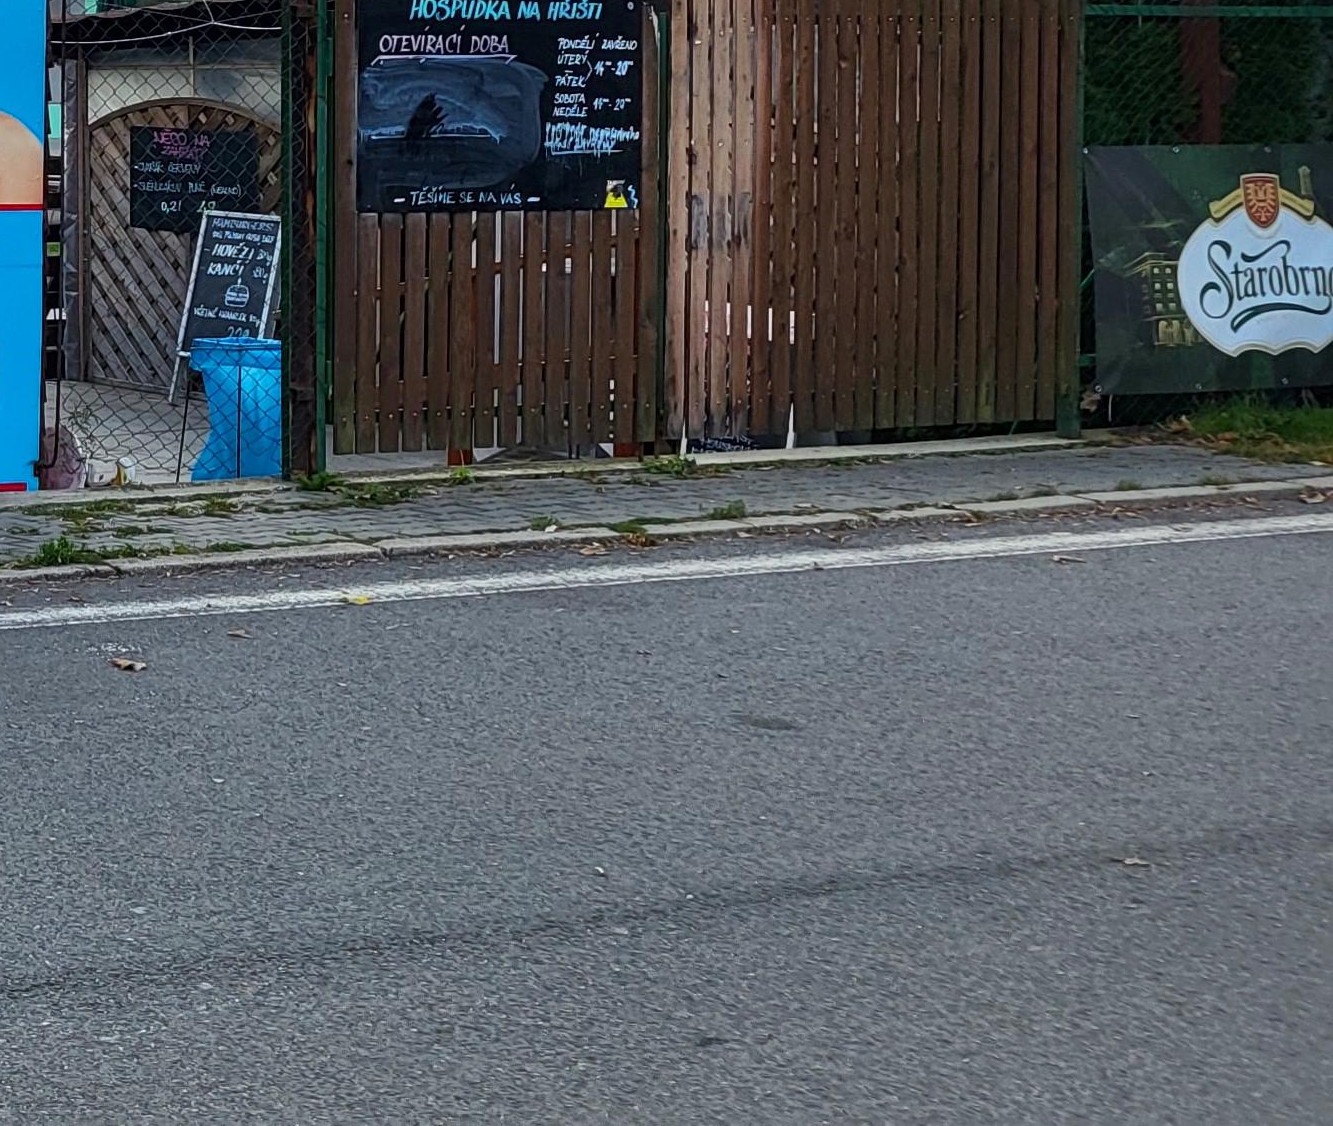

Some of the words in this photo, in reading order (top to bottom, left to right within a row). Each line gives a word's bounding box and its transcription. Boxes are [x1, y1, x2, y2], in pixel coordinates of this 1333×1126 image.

[517, 1, 541, 22] NA
[379, 25, 466, 54] OTEVÍRACÍ
[469, 35, 509, 54] DOBA
[554, 73, 587, 87] PÁTEK
[554, 93, 586, 104] SOBOTA
[458, 192, 475, 204] SE
[478, 191, 497, 204] NA
[500, 184, 522, 204] VÁS
